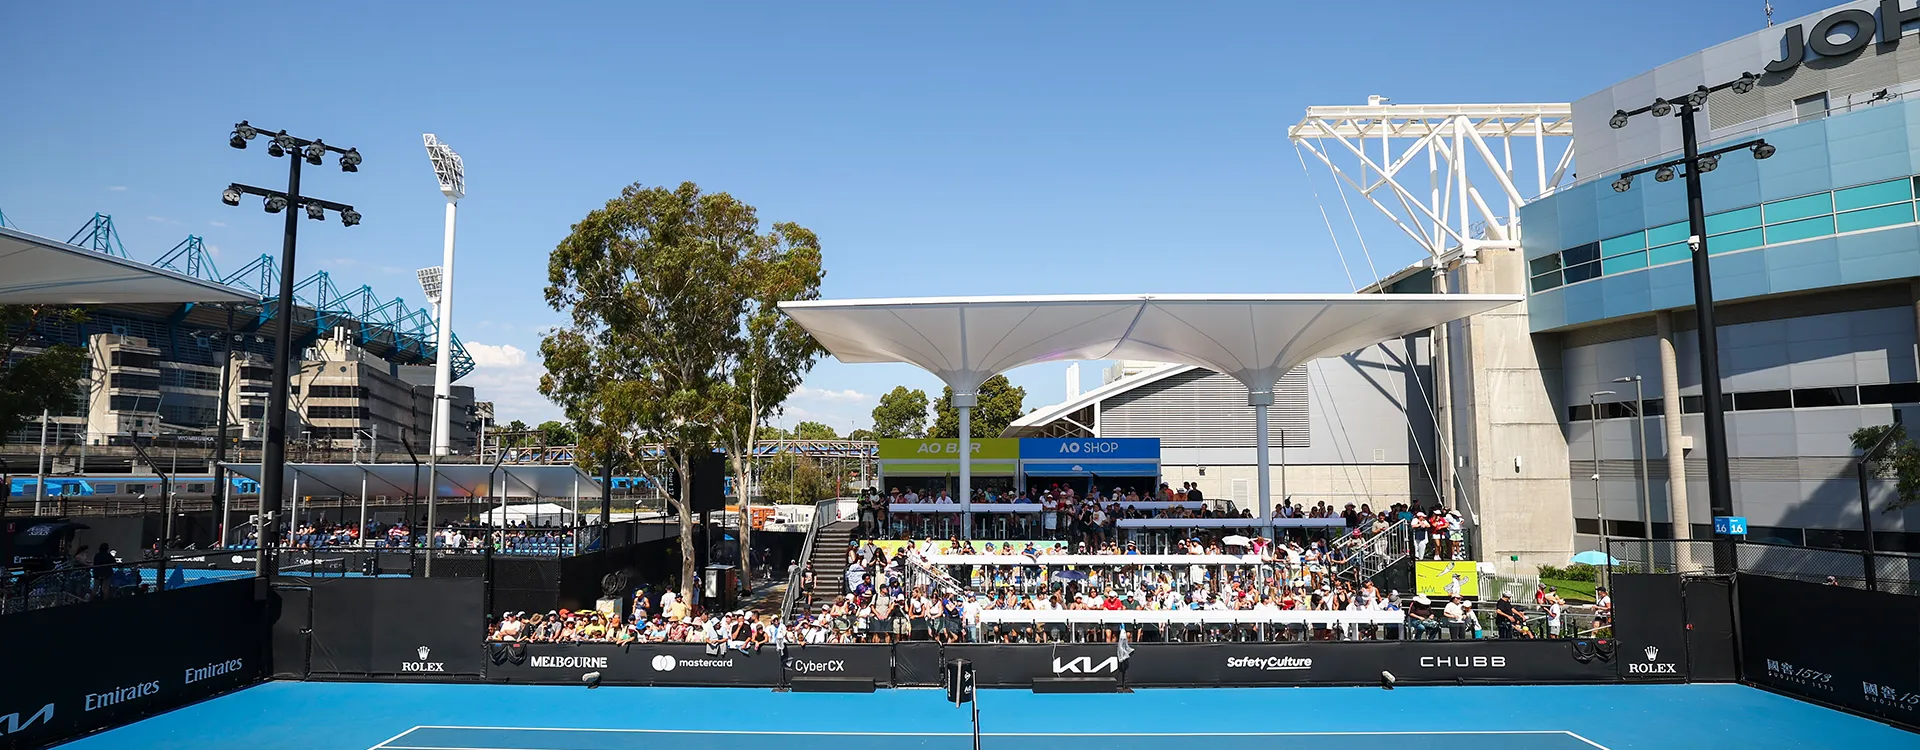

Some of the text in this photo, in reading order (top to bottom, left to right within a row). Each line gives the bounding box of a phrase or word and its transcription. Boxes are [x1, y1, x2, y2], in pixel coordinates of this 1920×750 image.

[917, 443, 980, 454] AO BR
[1059, 442, 1119, 454] AO SHOP
[1716, 523, 1727, 533] 16
[1731, 524, 1744, 533] 16
[402, 661, 444, 672] ROLEX
[530, 656, 607, 668] MELBOURNE
[679, 657, 733, 668] mastercard
[795, 659, 844, 674] CyberCX
[1227, 656, 1312, 670] SafetyCulture
[1420, 656, 1506, 668] CHUBB
[1629, 663, 1676, 673] ROLEX
[185, 657, 244, 684] Emirates
[1795, 667, 1832, 683] 1573
[85, 679, 160, 711] Emirates
